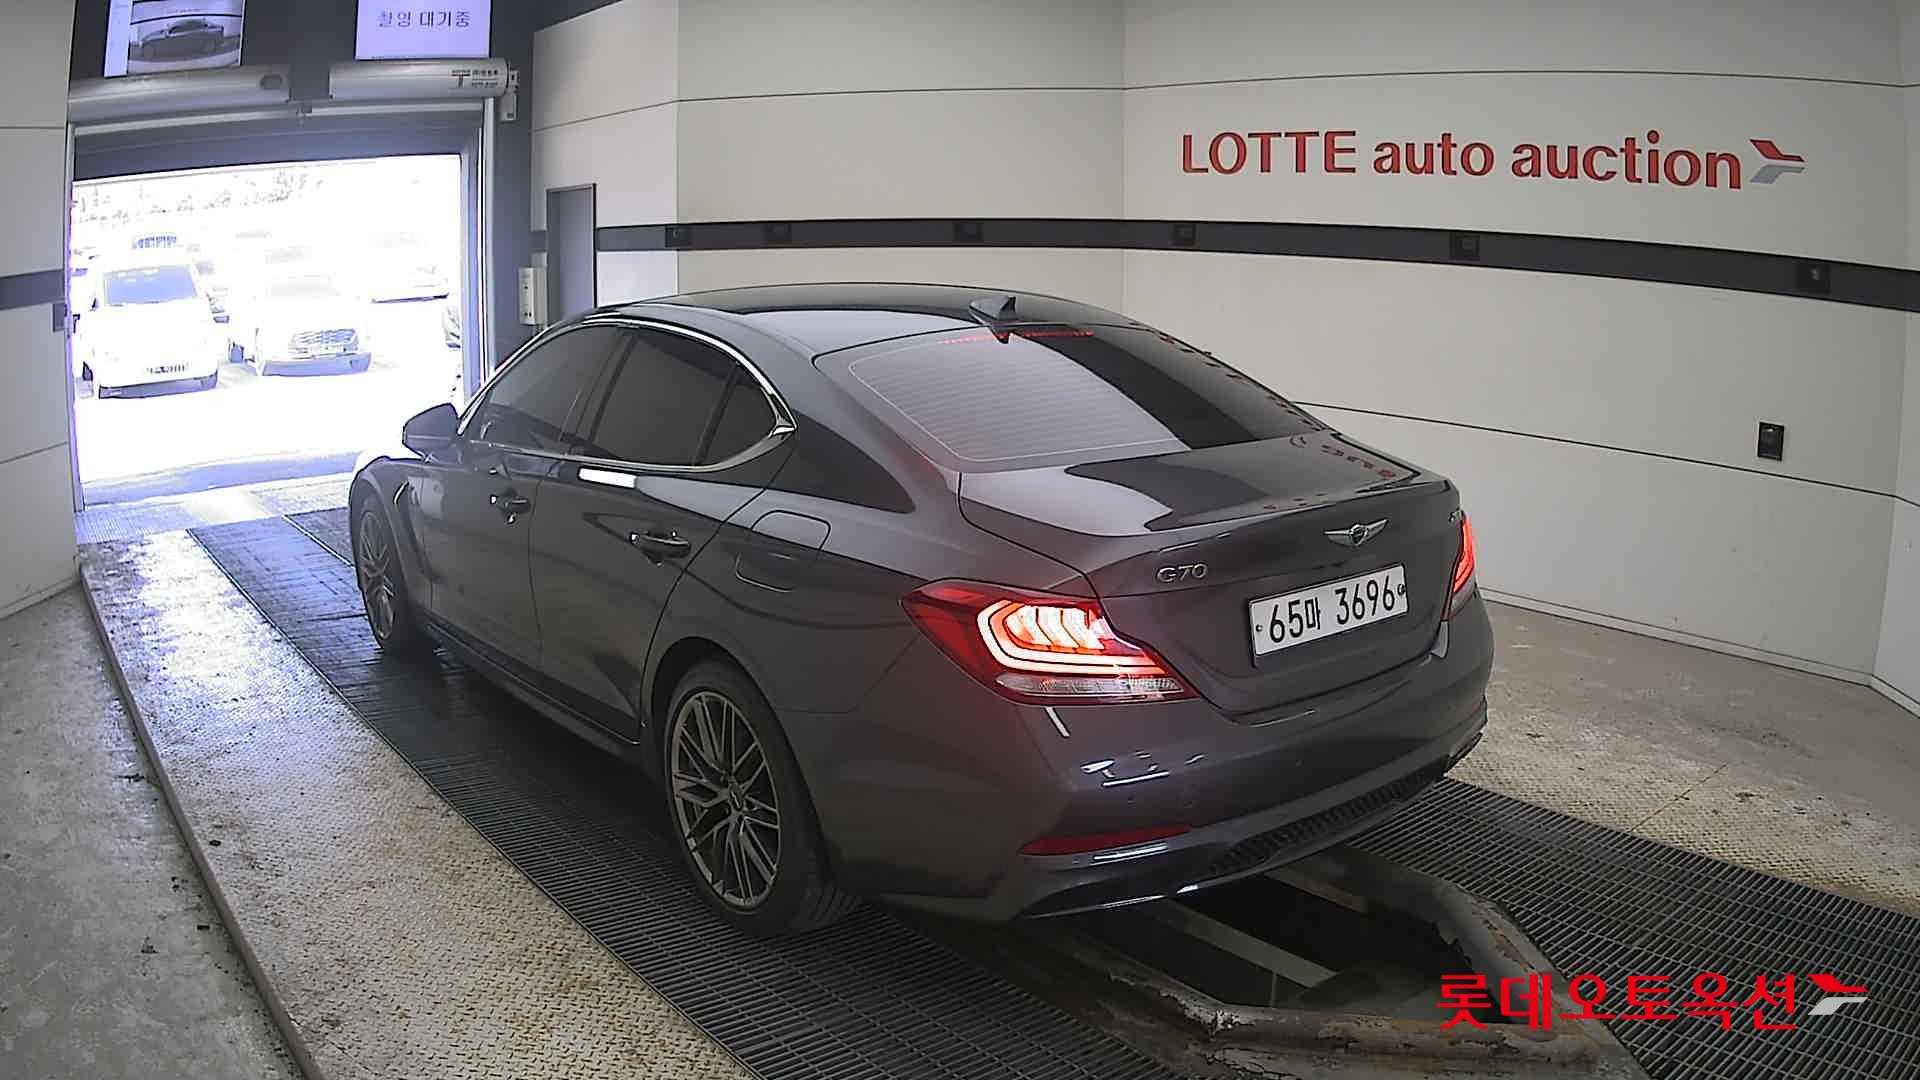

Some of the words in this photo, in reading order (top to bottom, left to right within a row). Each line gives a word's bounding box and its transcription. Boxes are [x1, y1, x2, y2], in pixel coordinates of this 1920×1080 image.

[420, 11, 471, 27] 대기중
[1183, 131, 1357, 173] LOTTE
[1374, 134, 1494, 177] auto
[1512, 131, 1741, 189] auction
[1157, 563, 1208, 583] G70
[1269, 597, 1321, 643] 65마
[1335, 575, 1396, 625] 3696
